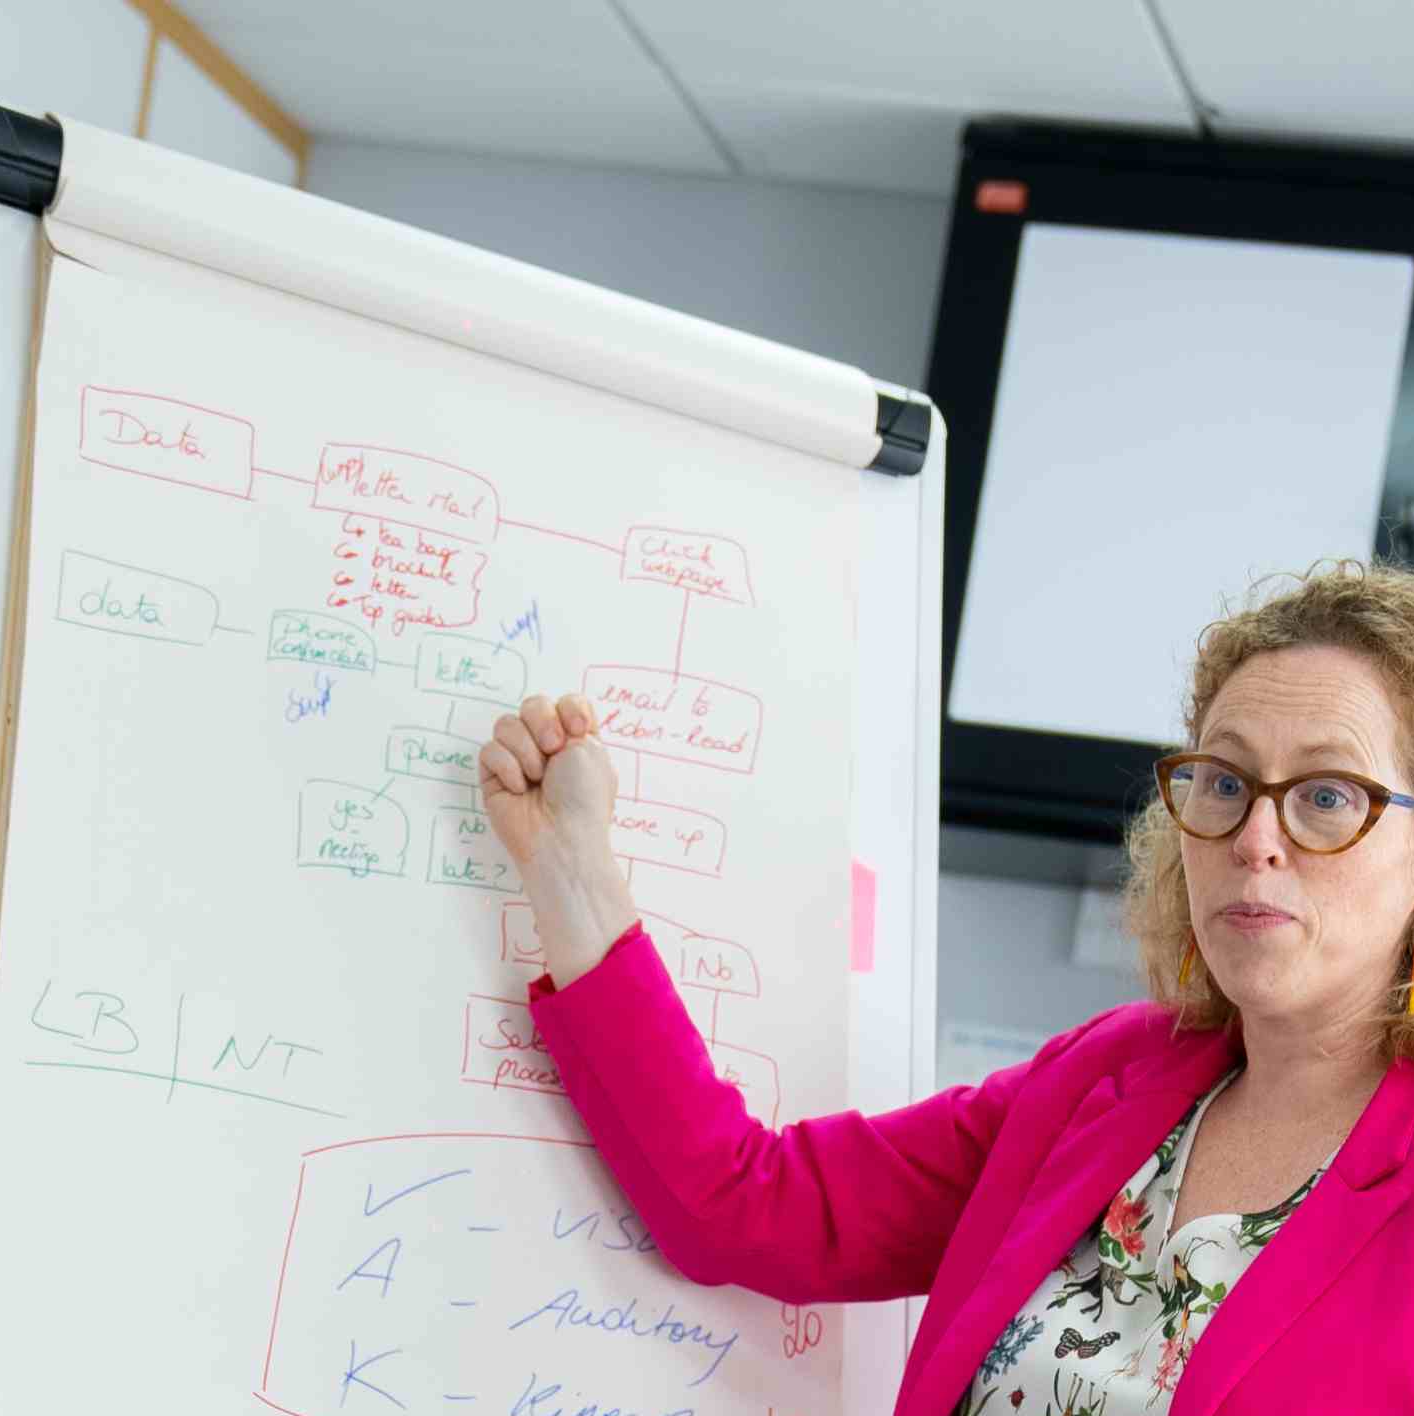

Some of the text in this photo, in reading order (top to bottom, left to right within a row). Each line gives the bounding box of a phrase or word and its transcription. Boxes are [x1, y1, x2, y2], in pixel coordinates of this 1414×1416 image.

[99, 409, 207, 460] Data
[353, 469, 413, 505] letter
[378, 522, 407, 550] tea
[78, 580, 165, 628] data
[370, 572, 420, 600] letter
[358, 595, 385, 631] Top
[598, 684, 712, 718] email to
[329, 799, 376, 832] yes
[458, 818, 487, 835] No
[675, 828, 705, 856] up
[695, 953, 734, 981] No
[29, 978, 142, 1056] LB
[211, 1032, 326, 1080] NT
[336, 1236, 402, 1299] A
[508, 1289, 741, 1388] Auditory
[338, 1337, 409, 1411] K
